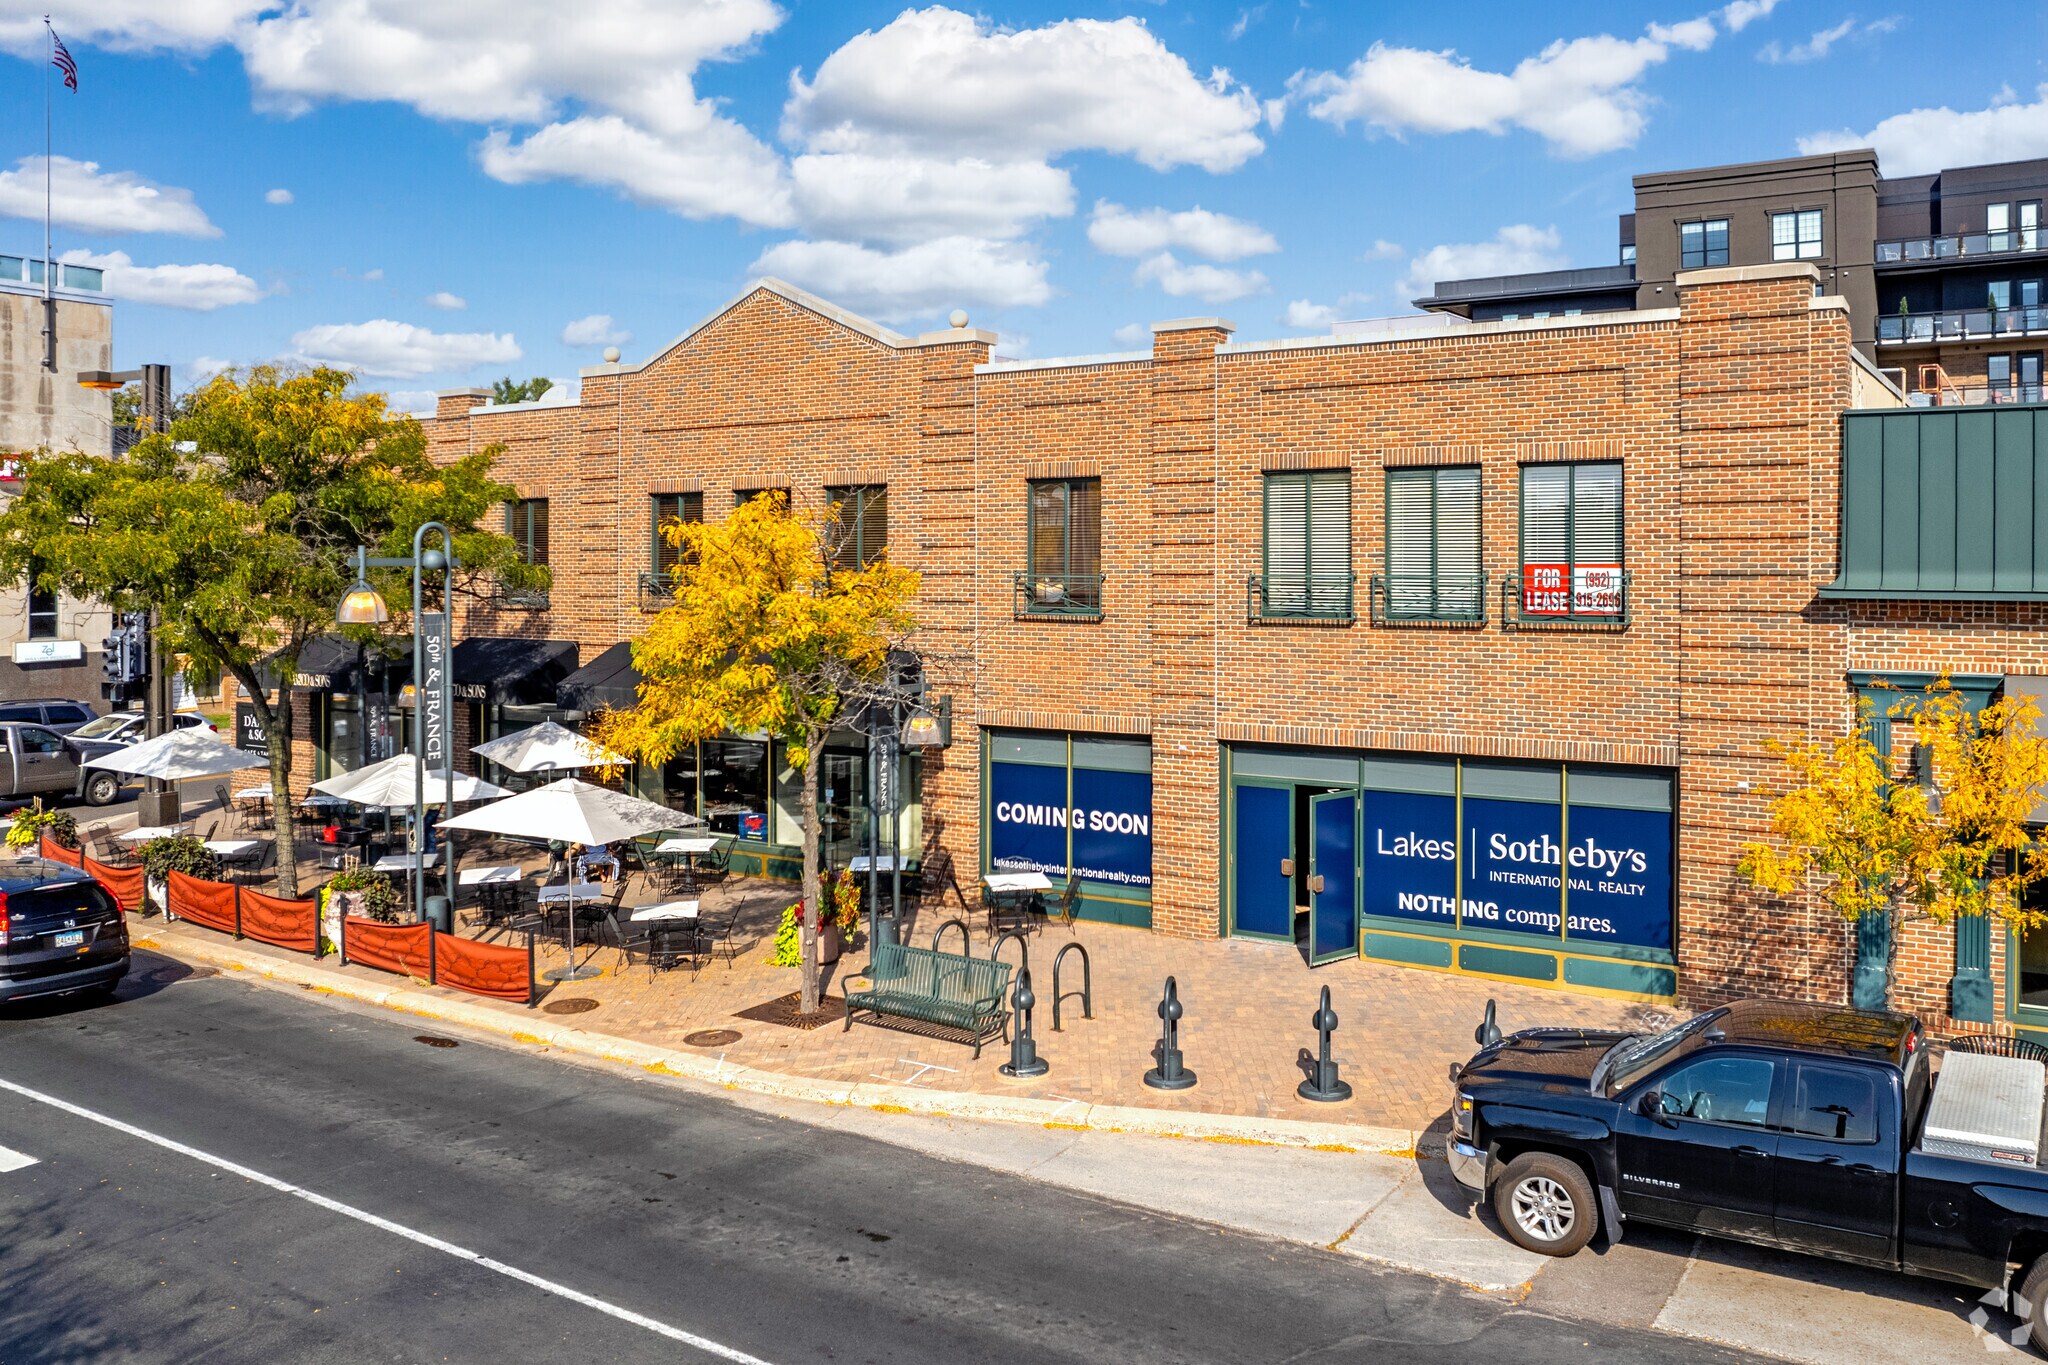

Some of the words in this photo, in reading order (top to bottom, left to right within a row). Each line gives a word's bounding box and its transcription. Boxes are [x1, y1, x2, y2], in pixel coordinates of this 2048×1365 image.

[1534, 568, 1560, 588] FOR
[1585, 570, 1610, 589] (952)
[1527, 591, 1567, 611] LEASE
[1576, 592, 1621, 608] 915-2696
[426, 635, 442, 663] 50th
[315, 674, 331, 688] SONS
[426, 668, 441, 687] &
[467, 684, 486, 699] SONS
[426, 690, 441, 761] FRANCE
[369, 728, 377, 758] FRANCE
[880, 760, 888, 772] &
[880, 772, 888, 811] FRANCE
[996, 801, 1086, 830] COMING
[1089, 810, 1149, 836] SOON
[1378, 828, 1456, 861] Lakes
[1489, 832, 1648, 877] Sotheby's
[993, 857, 1151, 885] lakessothebysinternationalrealty.com
[1489, 870, 1594, 892] INTERNATIONAL
[1599, 880, 1646, 897] REALTY
[1398, 892, 1499, 921] NOTHING
[1505, 907, 1617, 934] compares.
[1623, 1173, 1680, 1189] SILVERADO
